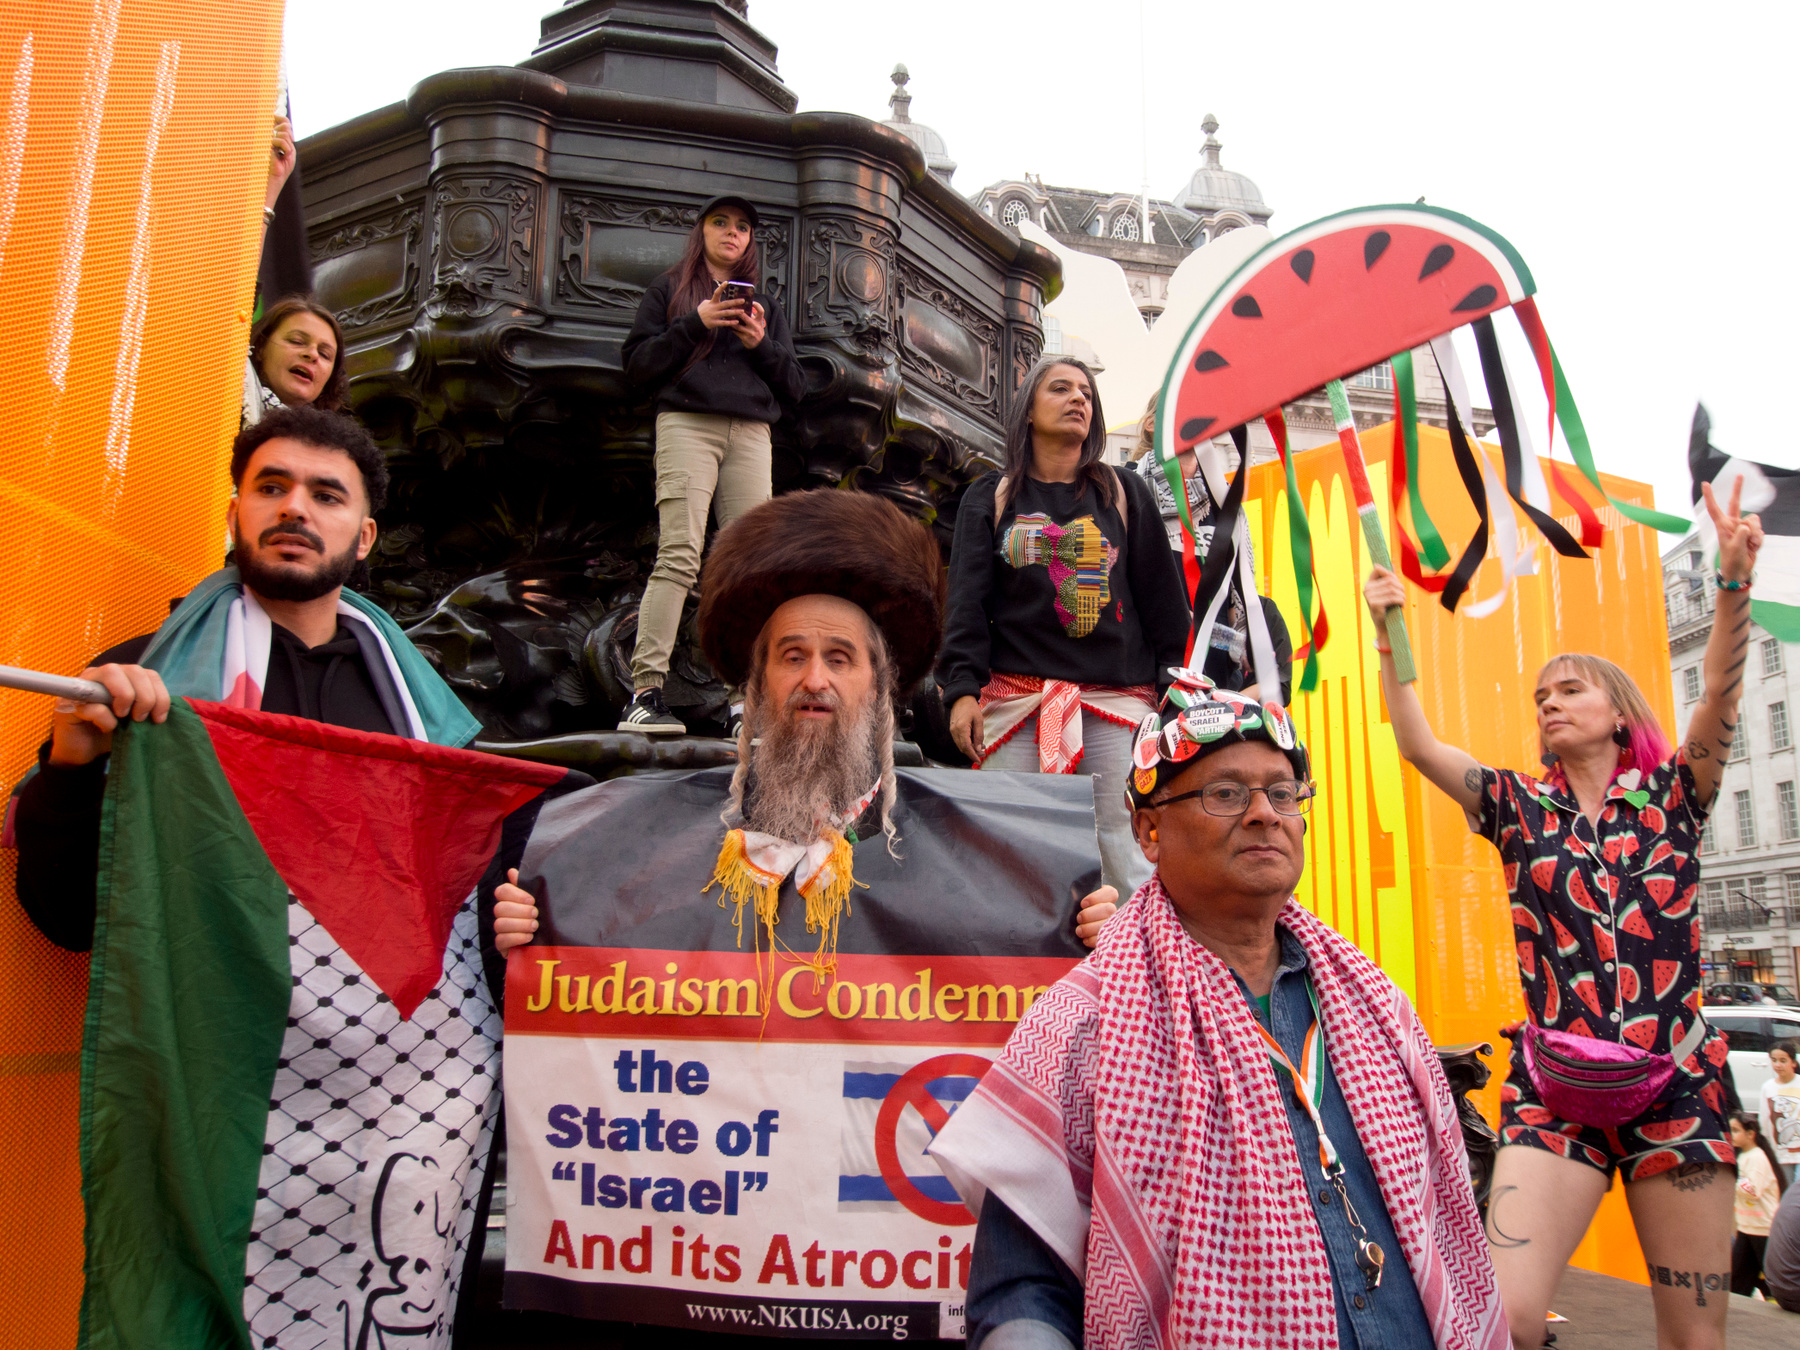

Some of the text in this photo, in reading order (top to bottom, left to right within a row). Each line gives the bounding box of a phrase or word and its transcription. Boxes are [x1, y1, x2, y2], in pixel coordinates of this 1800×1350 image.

[1189, 706, 1226, 718] BOYCOTT
[1171, 732, 1180, 750] FREE
[1139, 774, 1153, 790] GAZA
[526, 960, 761, 1015] Judaism
[613, 1049, 710, 1096] the
[545, 1103, 780, 1157] State of
[551, 1160, 769, 1216] “Israel”
[543, 1219, 653, 1274] And
[670, 1224, 742, 1283] its
[685, 1303, 909, 1340] www.NKUSA.org
[948, 1304, 966, 1317] inf
